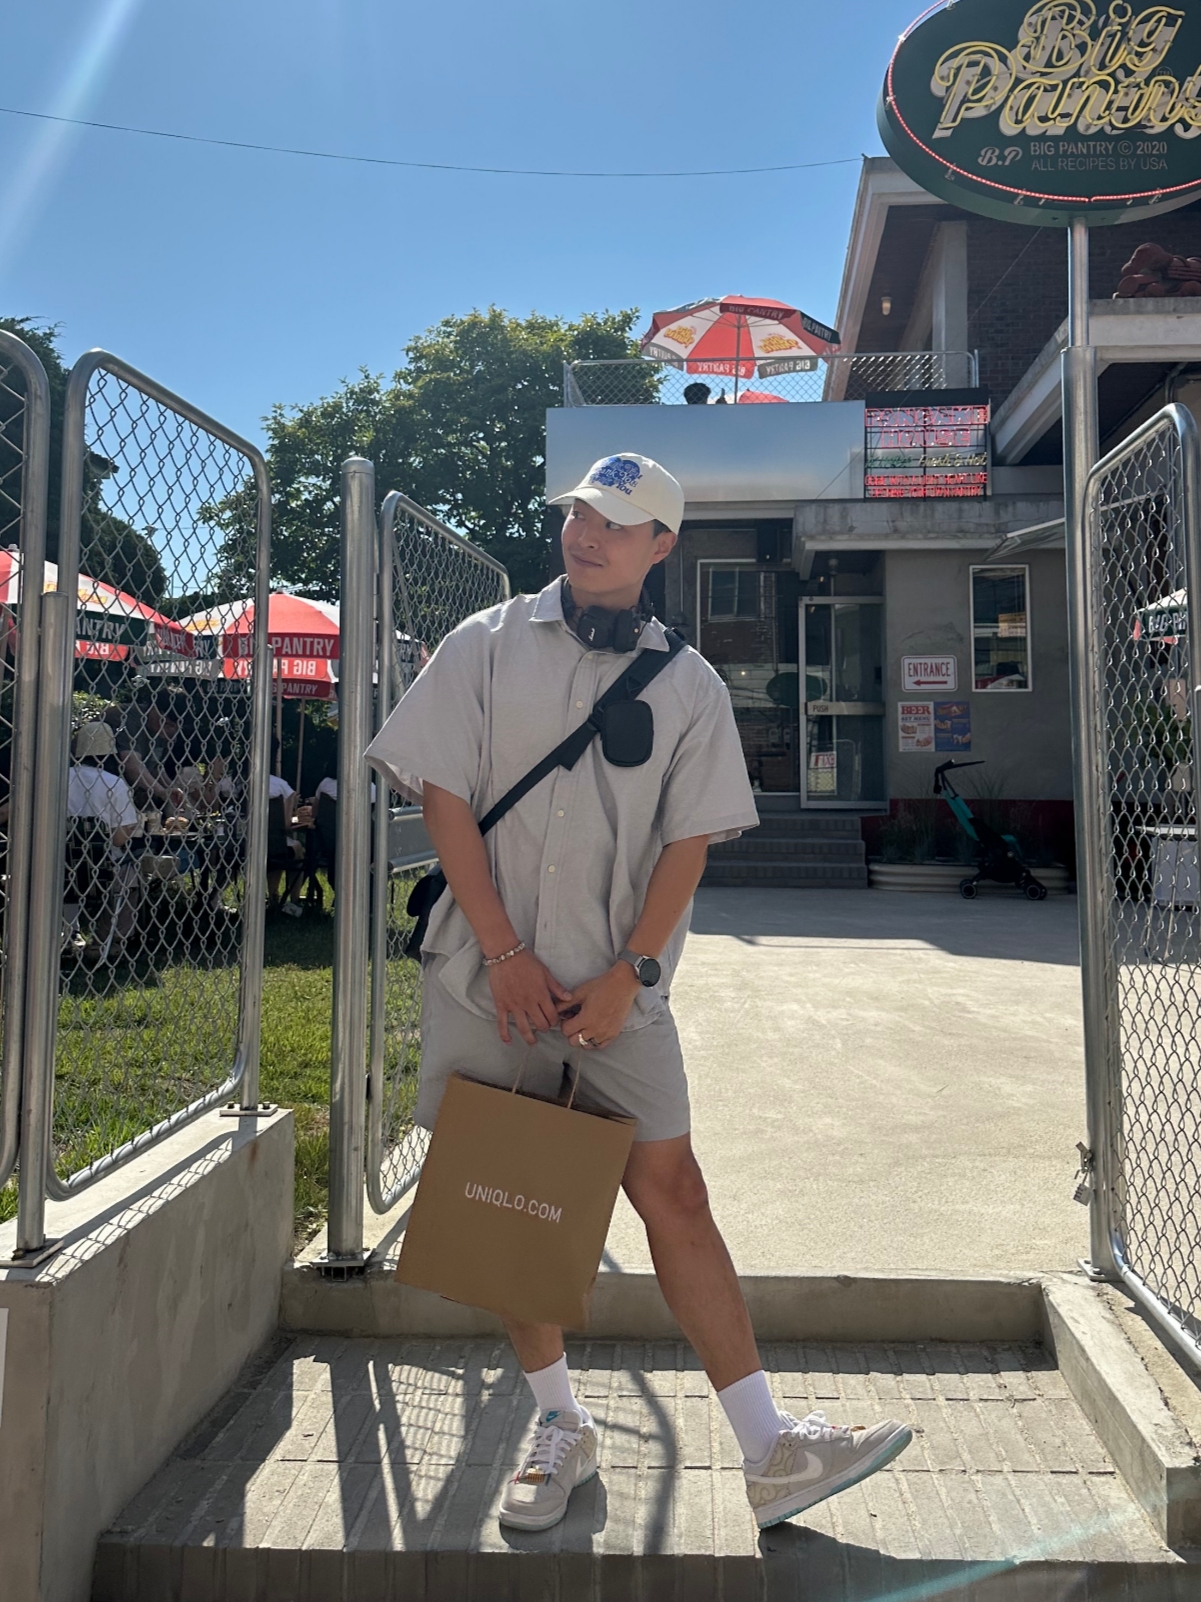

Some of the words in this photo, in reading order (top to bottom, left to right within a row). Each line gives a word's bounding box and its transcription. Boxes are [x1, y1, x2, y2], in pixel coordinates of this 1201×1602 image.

[1008, 0, 1185, 80] Big
[1031, 142, 1055, 155] BIG
[1059, 142, 1115, 155] PANTRY
[1136, 141, 1168, 155] 2020
[1031, 158, 1055, 171] ALL
[1058, 158, 1116, 171] RECIPES
[1120, 158, 1137, 170] BY
[1140, 158, 1168, 170] USA
[271, 637, 334, 656] PANTRY
[908, 662, 951, 677] ENTRANCE
[813, 704, 829, 713] PUSH
[465, 1182, 562, 1223] UNIQLO.COM
